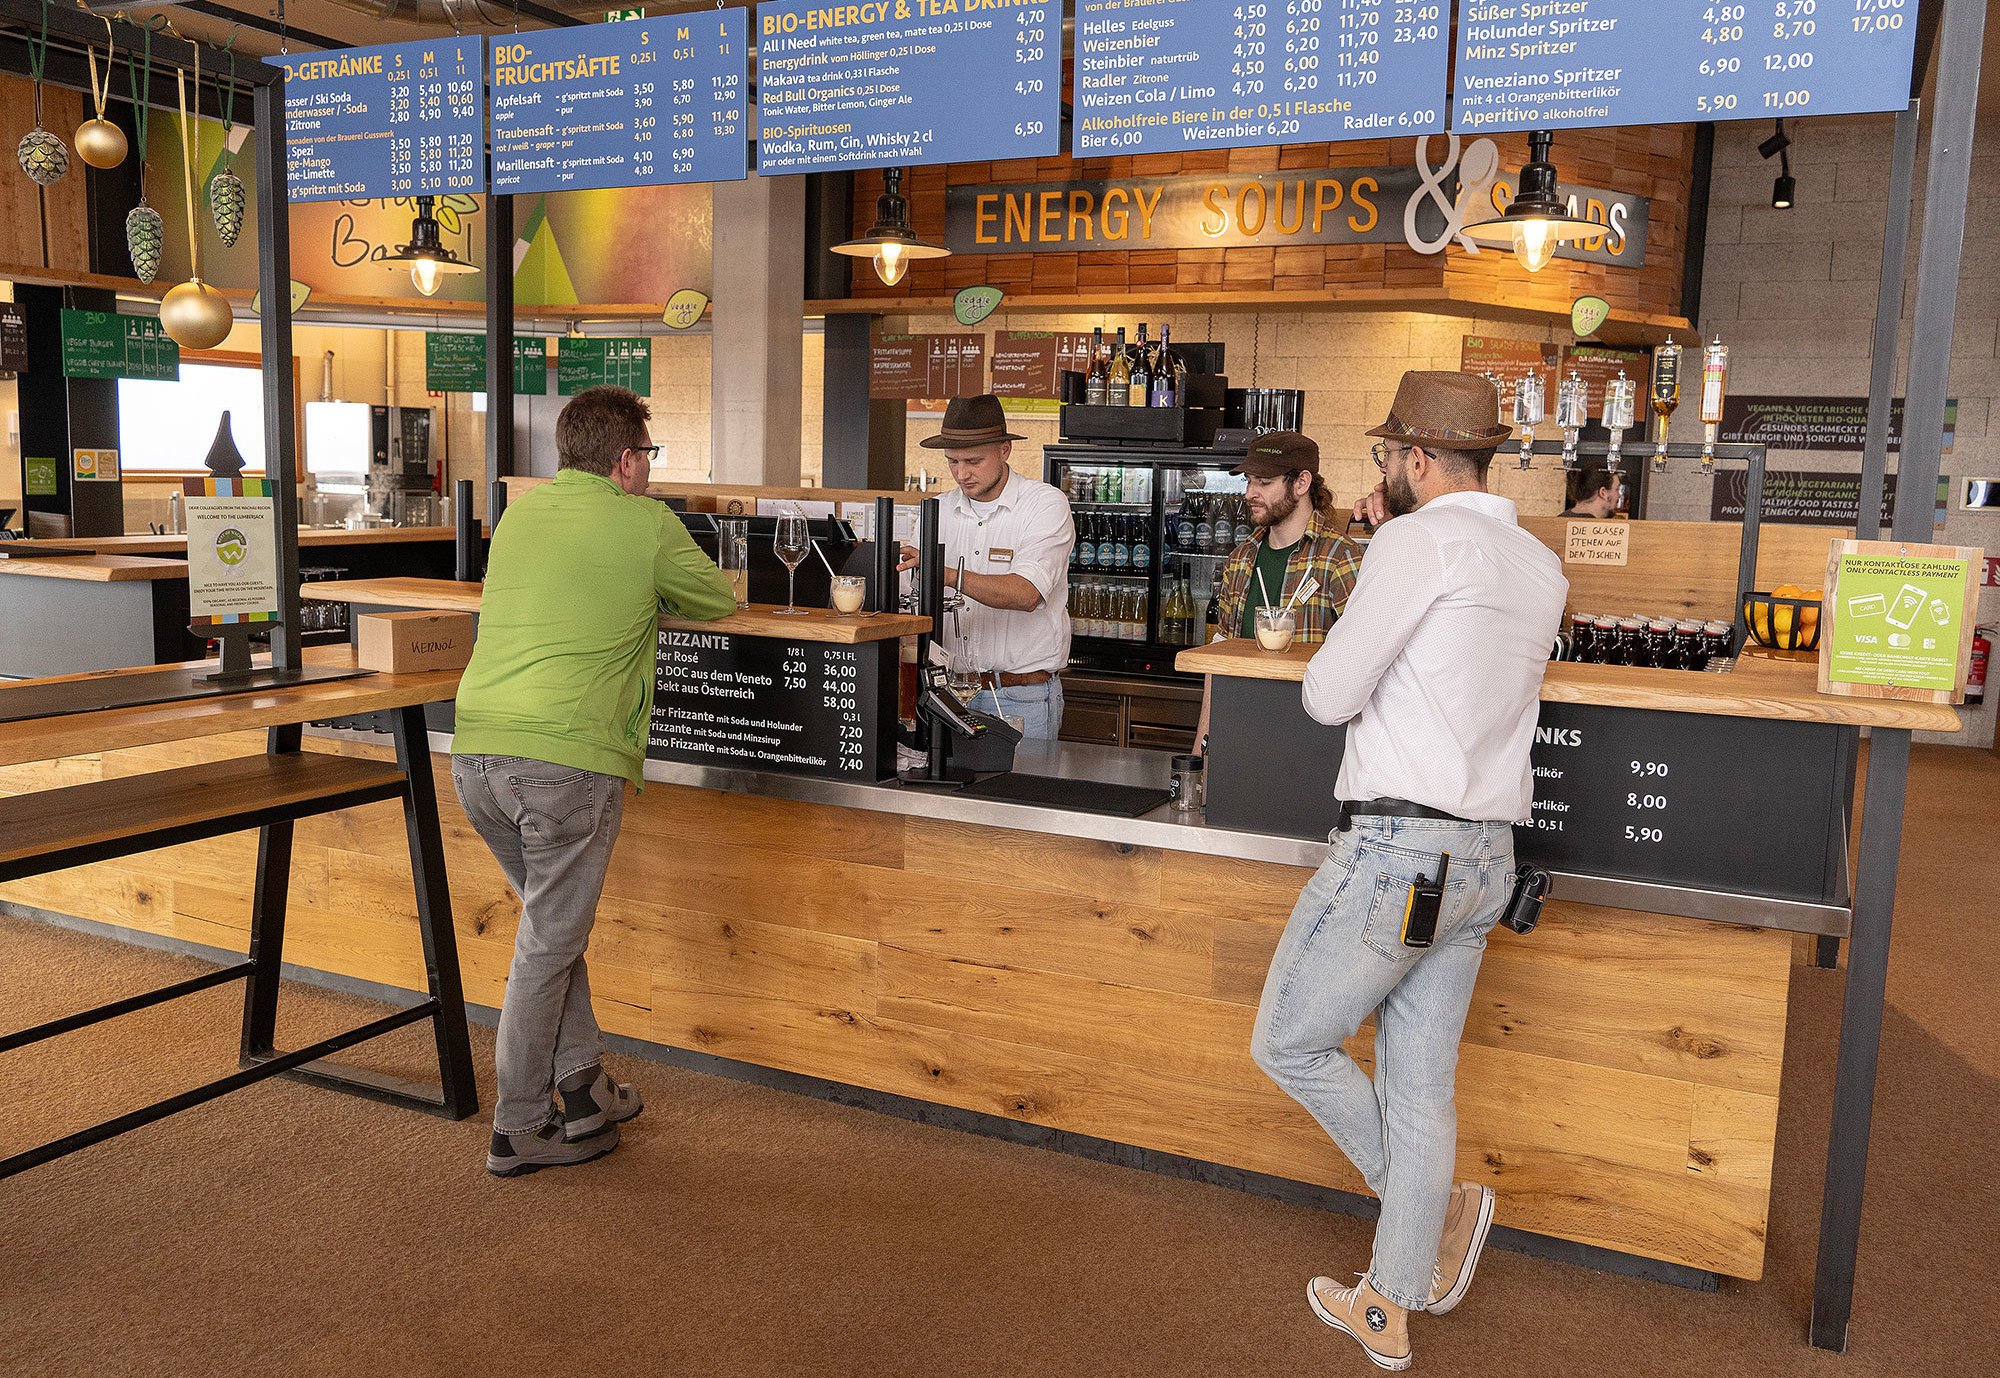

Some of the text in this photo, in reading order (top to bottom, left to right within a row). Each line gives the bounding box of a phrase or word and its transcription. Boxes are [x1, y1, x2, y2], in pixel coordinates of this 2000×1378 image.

[1084, 3, 1103, 12] von
[1287, 0, 1322, 15] 6,00
[1394, 5, 1439, 25] 23,40
[1468, 0, 1589, 22] Süßer Spritzer
[1775, 0, 1816, 19] 8,70
[762, 2, 888, 36] BIO-ENERGY
[894, 2, 910, 20] &
[919, 0, 958, 16] TEA
[970, 19, 992, 30] Dose
[1016, 10, 1044, 26] 4,70
[1131, 17, 1175, 31] Edelguss
[677, 27, 689, 41] M
[1467, 15, 1618, 42] Holunder Spritzer
[1773, 13, 1903, 40] 8,70 17,00
[1083, 34, 1160, 53] Weizenbier
[1285, 25, 1438, 54] 6,20 11,70 23,40
[496, 44, 532, 65] BIO-
[1510, 38, 1577, 60] Spritzer
[762, 48, 908, 72] Energydrink Höllinger 0,25
[1082, 54, 1144, 71] Steinbier
[496, 54, 620, 86] FRUCHTSÄFTE
[712, 74, 738, 87] 11,20
[762, 72, 805, 88] Makava
[1133, 72, 1169, 85] Zitrone
[1463, 66, 1623, 91] Veneziano Spritzer
[419, 80, 473, 96] 5,40 10,60
[808, 85, 855, 102] Organics
[1495, 84, 1621, 105] cl Orangenbitterlikör
[448, 93, 473, 106] 10,60
[496, 92, 541, 109] Apfelsaft
[869, 97, 897, 108] Ginger
[1082, 92, 1132, 108] Weizen
[419, 108, 441, 121] 4,90
[673, 109, 739, 125] 5,90 11,40
[1081, 98, 1352, 132] Alkoholfreie Flasche
[1461, 106, 1539, 127] Aperitivo
[290, 121, 320, 131] Zitrone
[496, 121, 624, 140] Traubensaft Soda
[762, 122, 852, 140] BIO-Spirituosen
[1183, 113, 1395, 141] Weizenbier Radler
[364, 130, 394, 141] Gusswerk
[762, 131, 911, 156] Wodka, Whisky
[292, 146, 313, 157] Spezi
[634, 150, 653, 163] 4,10
[798, 149, 877, 164] mit Softdrink
[497, 156, 554, 172] Marillensaft
[392, 176, 473, 191] 3,00 10,00
[562, 172, 574, 181] pur
[975, 185, 1165, 246] ENERGY
[1199, 175, 1380, 240] SOUPS
[1795, 406, 1862, 414] VEGETARISCHE
[1760, 424, 1858, 434] GESUNDES SCHMECKT
[1721, 433, 1856, 444] GIBT ENERGIE UND SORGT FÜR
[1798, 481, 1853, 489] VEGETARIAN
[1775, 489, 1813, 498] HIGHEST
[1815, 490, 1857, 499] ORGANIC
[1765, 508, 1799, 517] ENERGY
[1795, 500, 1853, 509] FOOD TASTES
[1572, 526, 1587, 535] DIE
[1570, 538, 1603, 547] STEHEN
[1569, 550, 1621, 559] DEN TISCHEN
[1863, 561, 1920, 569] KONTAKTLOSE
[1922, 563, 1960, 571] ZAHLUNG
[1868, 568, 1920, 577] CONTACTLESS
[1854, 635, 1878, 644] VISA
[824, 651, 841, 660] 0,75
[665, 666, 856, 694] DOC Veneto 44,00
[701, 685, 755, 700] Österreich
[668, 707, 714, 722] Frizzante
[767, 720, 803, 732] Holunder
[839, 725, 863, 739] 7,20
[843, 712, 856, 722] 0,3
[744, 733, 863, 754] Minzsirup 7,20
[670, 738, 715, 752] Frizzante
[717, 745, 729, 754] mit
[758, 751, 827, 766] Orangenbitterlikör
[1630, 760, 1668, 777] 9,90
[1627, 792, 1667, 810] 8,00
[1537, 819, 1557, 831] 0,5
[1624, 825, 1663, 843] 5,90
